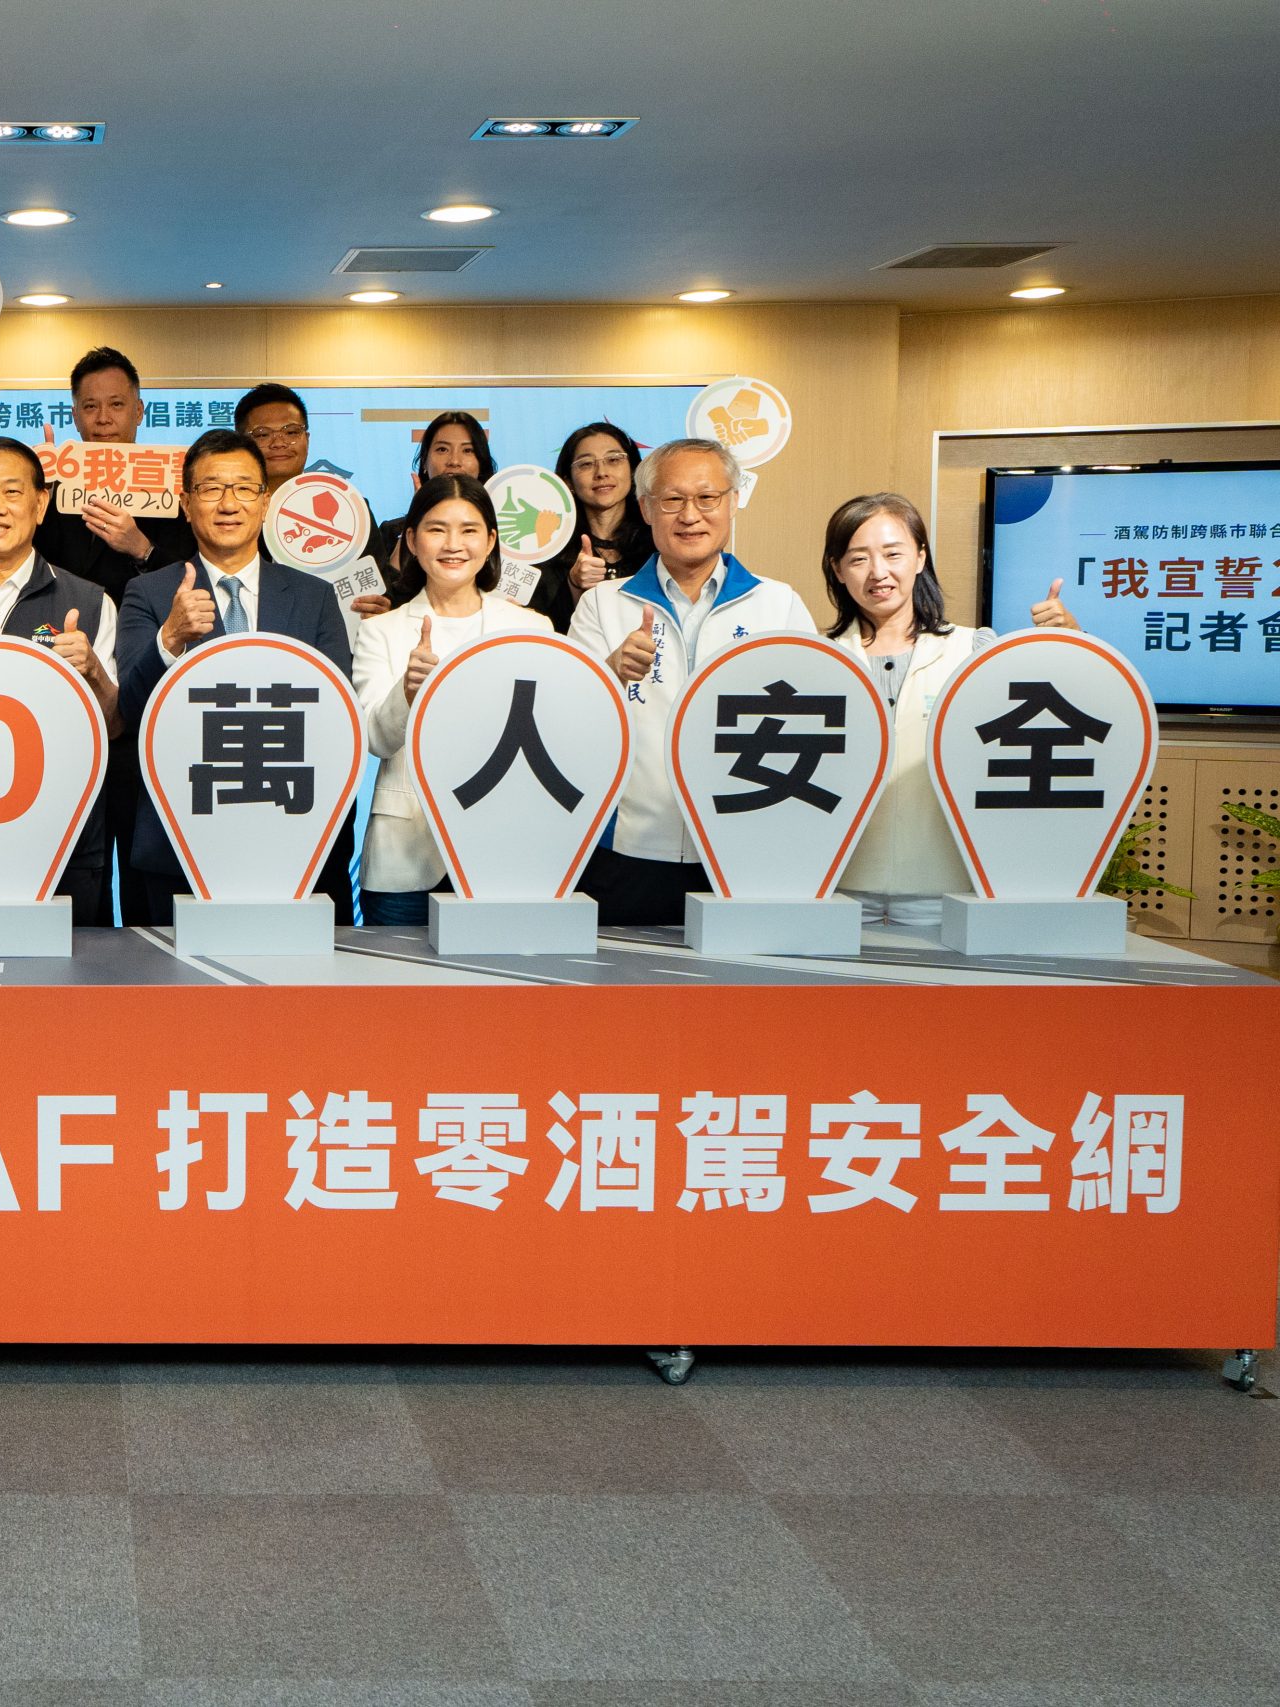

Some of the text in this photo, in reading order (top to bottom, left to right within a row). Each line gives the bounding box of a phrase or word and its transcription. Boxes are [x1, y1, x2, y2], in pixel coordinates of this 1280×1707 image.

[140, 487, 174, 510] 2.0
[188, 683, 320, 816] 萬
[451, 679, 586, 815] 人
[712, 679, 847, 815] 安
[975, 681, 1113, 810] 全
[155, 1089, 1186, 1214] 打造零酒駕安全網
